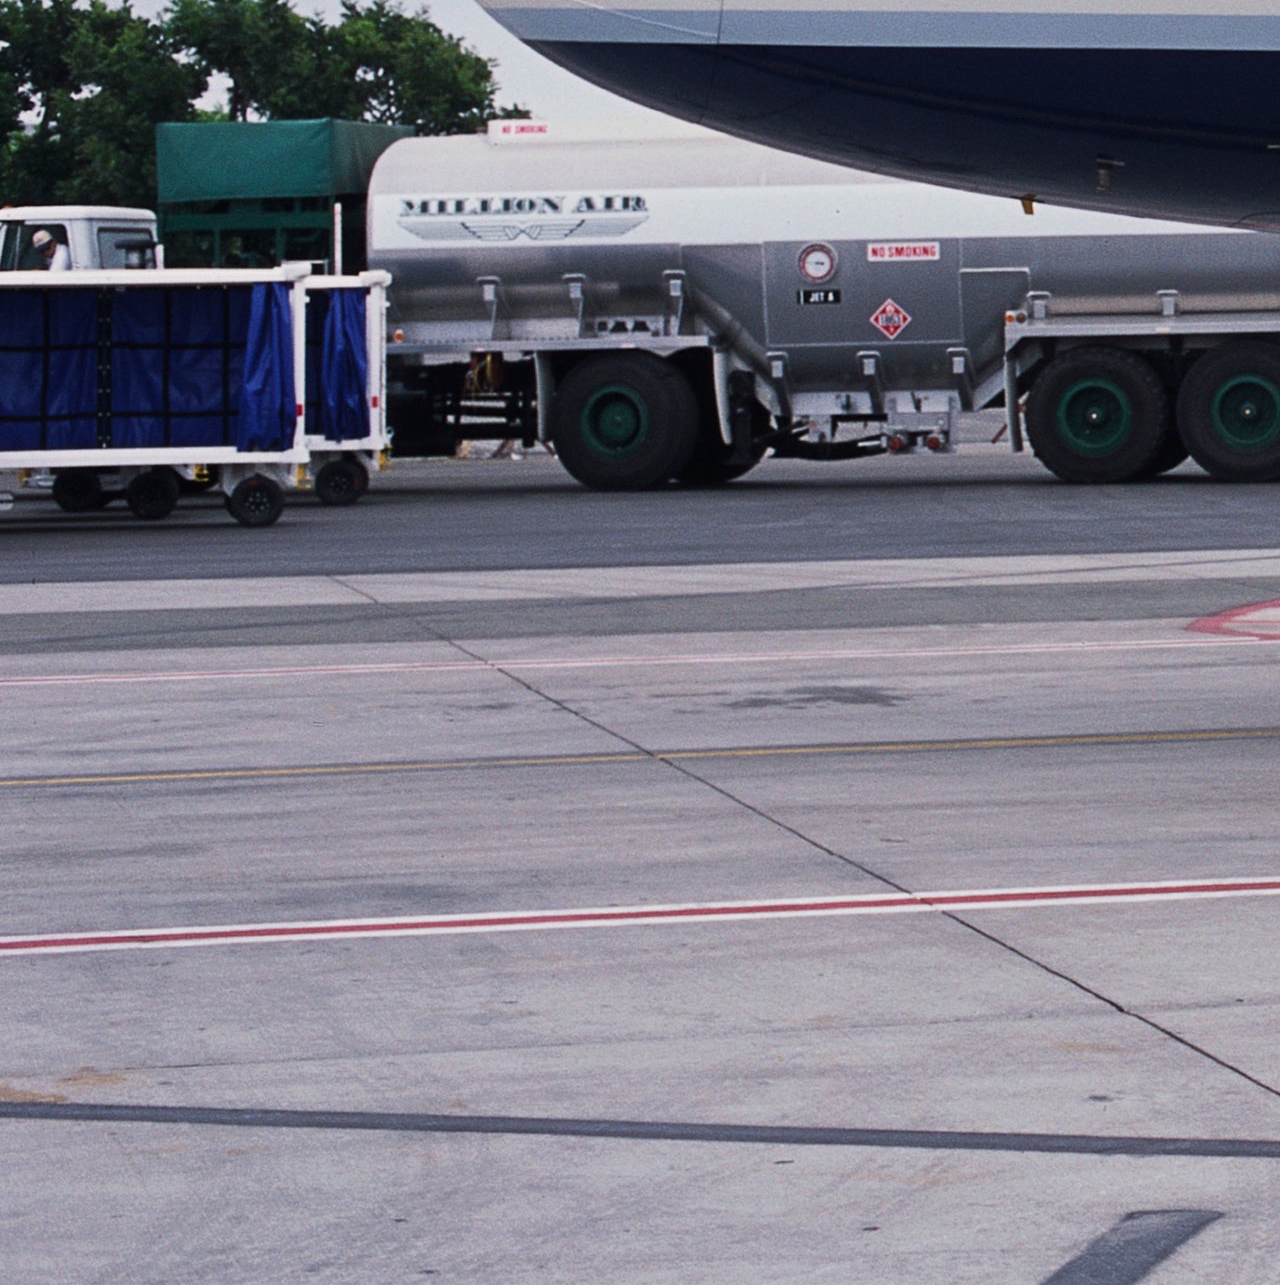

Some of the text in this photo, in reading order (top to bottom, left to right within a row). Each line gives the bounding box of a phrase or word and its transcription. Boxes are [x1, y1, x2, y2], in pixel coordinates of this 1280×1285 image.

[400, 194, 649, 216] MILLION AIR
[871, 245, 937, 258] NO SMOKING
[809, 292, 825, 303] JET
